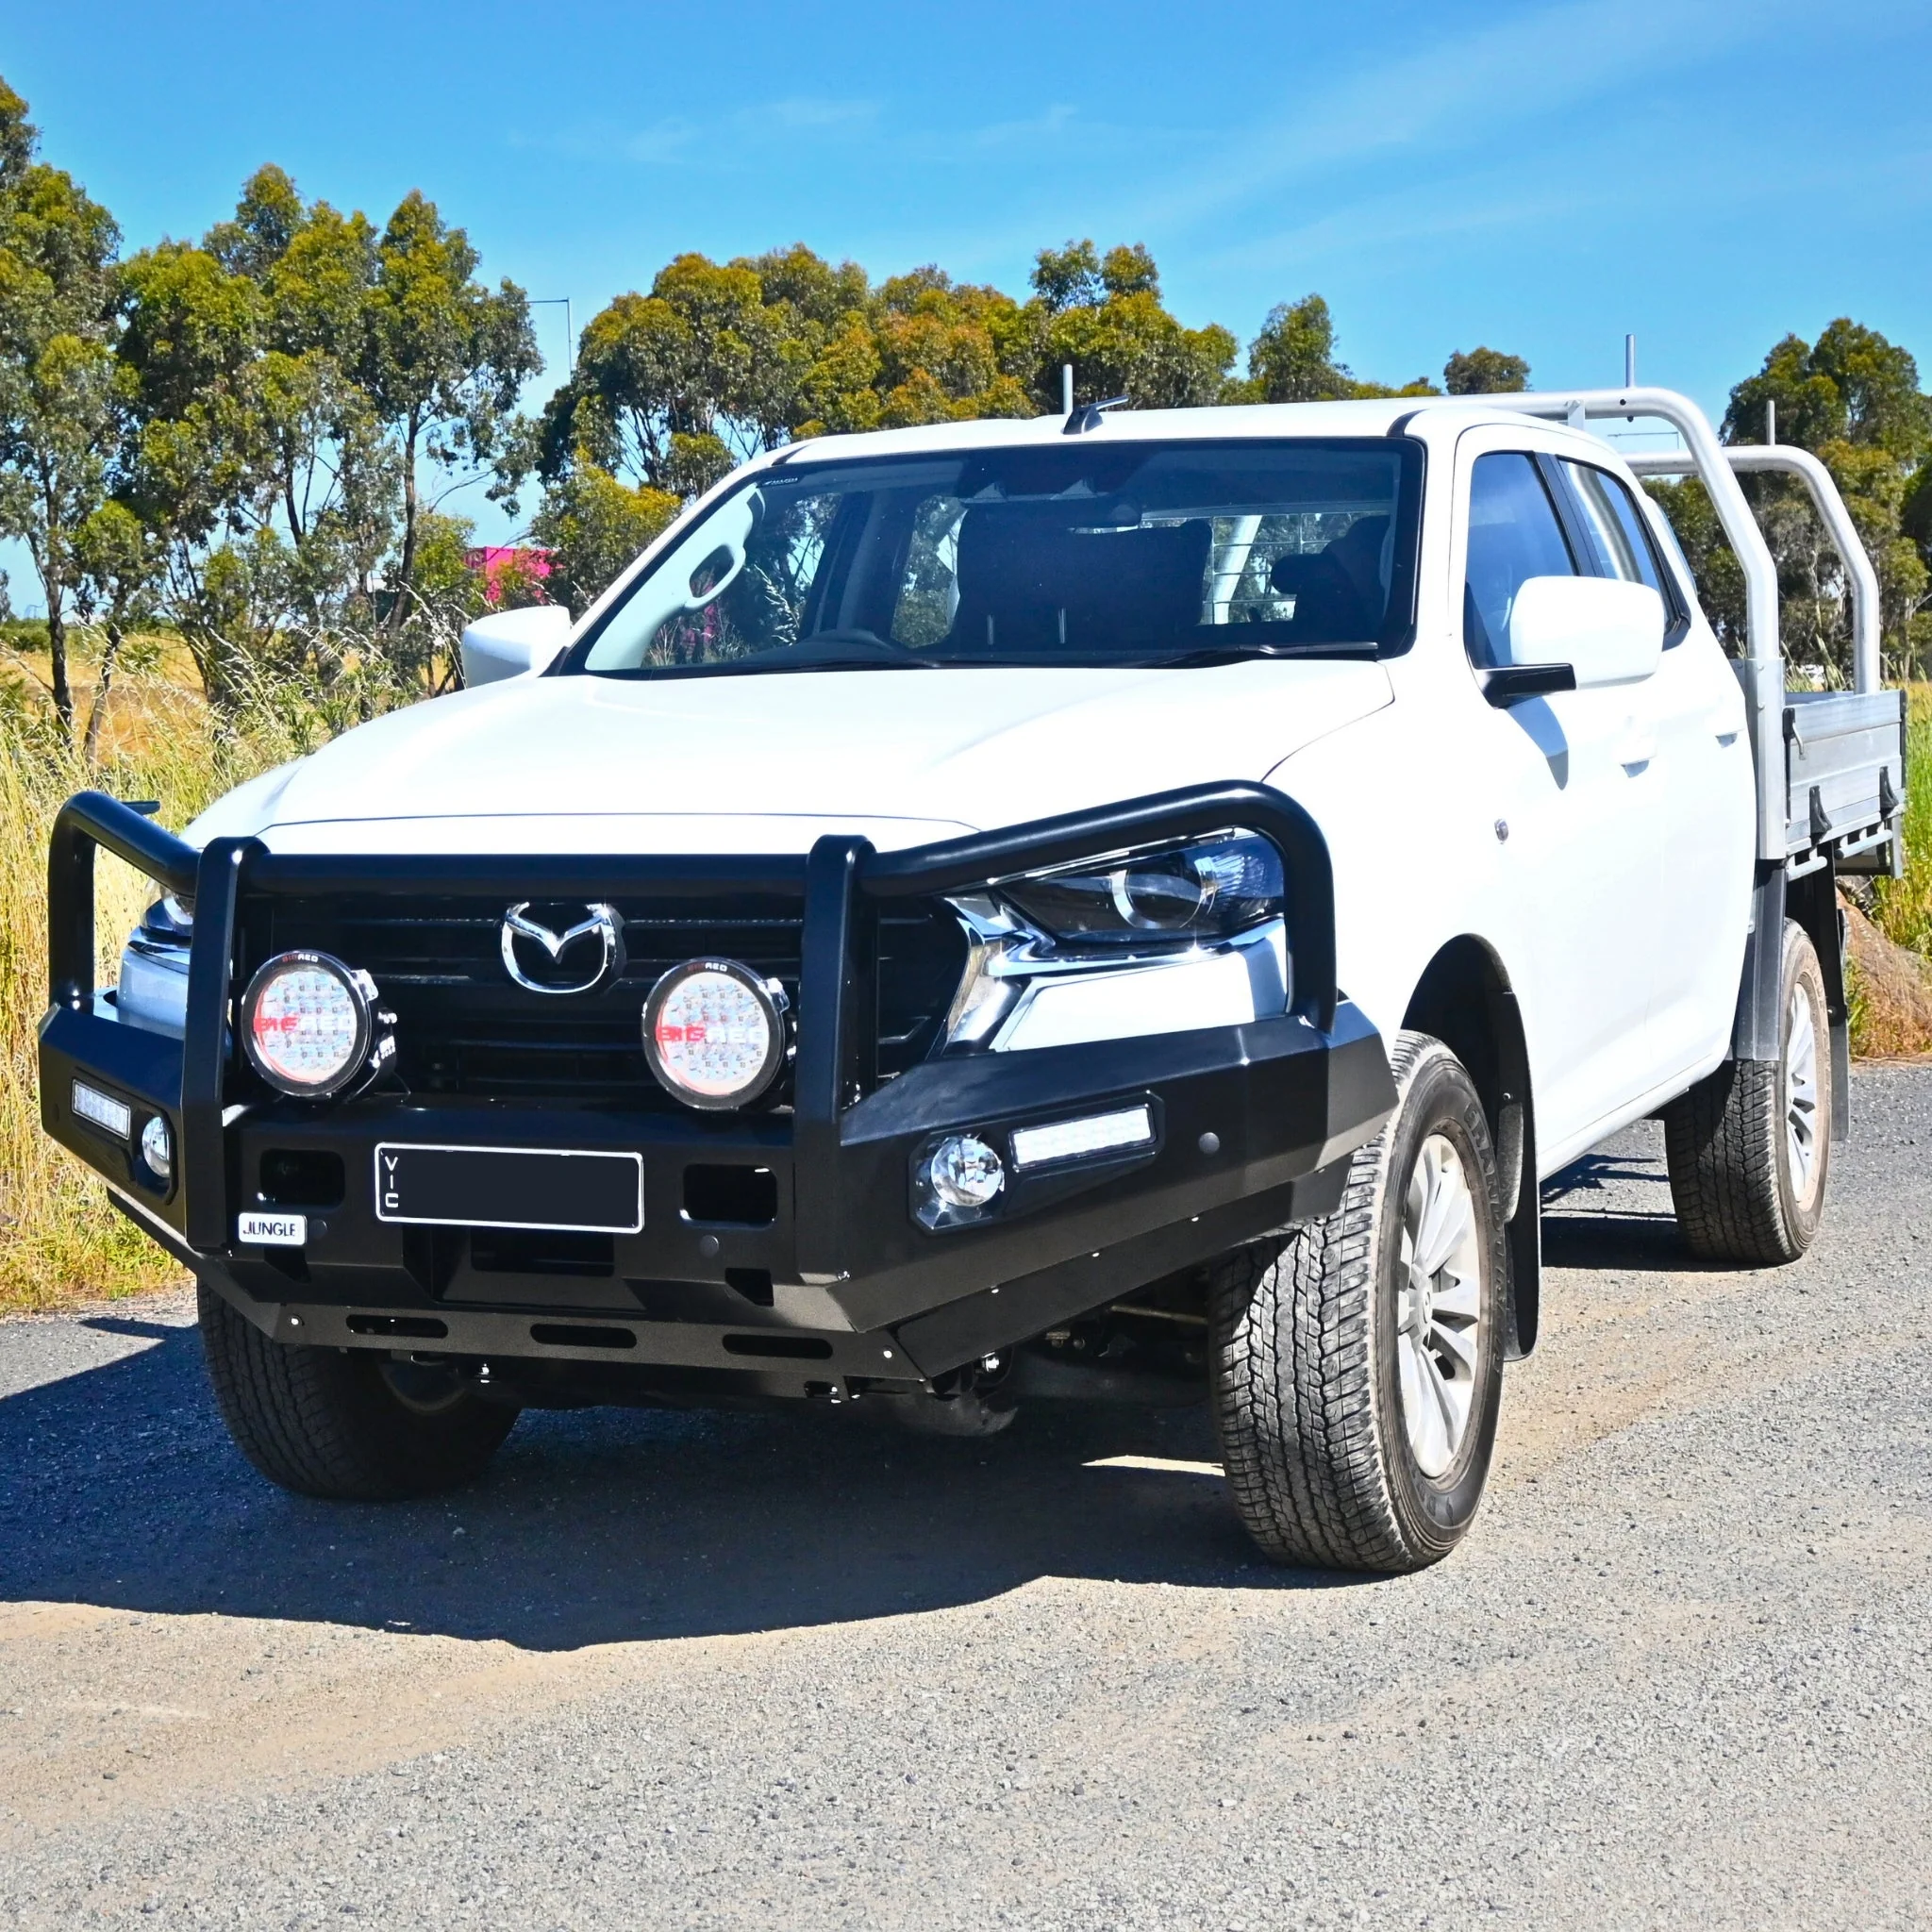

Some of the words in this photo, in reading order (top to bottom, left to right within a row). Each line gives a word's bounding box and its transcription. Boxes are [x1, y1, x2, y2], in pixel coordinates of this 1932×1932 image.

[687, 961, 728, 973] RED
[385, 1156, 399, 1208] VIC
[242, 1221, 296, 1237] JUNGLE
